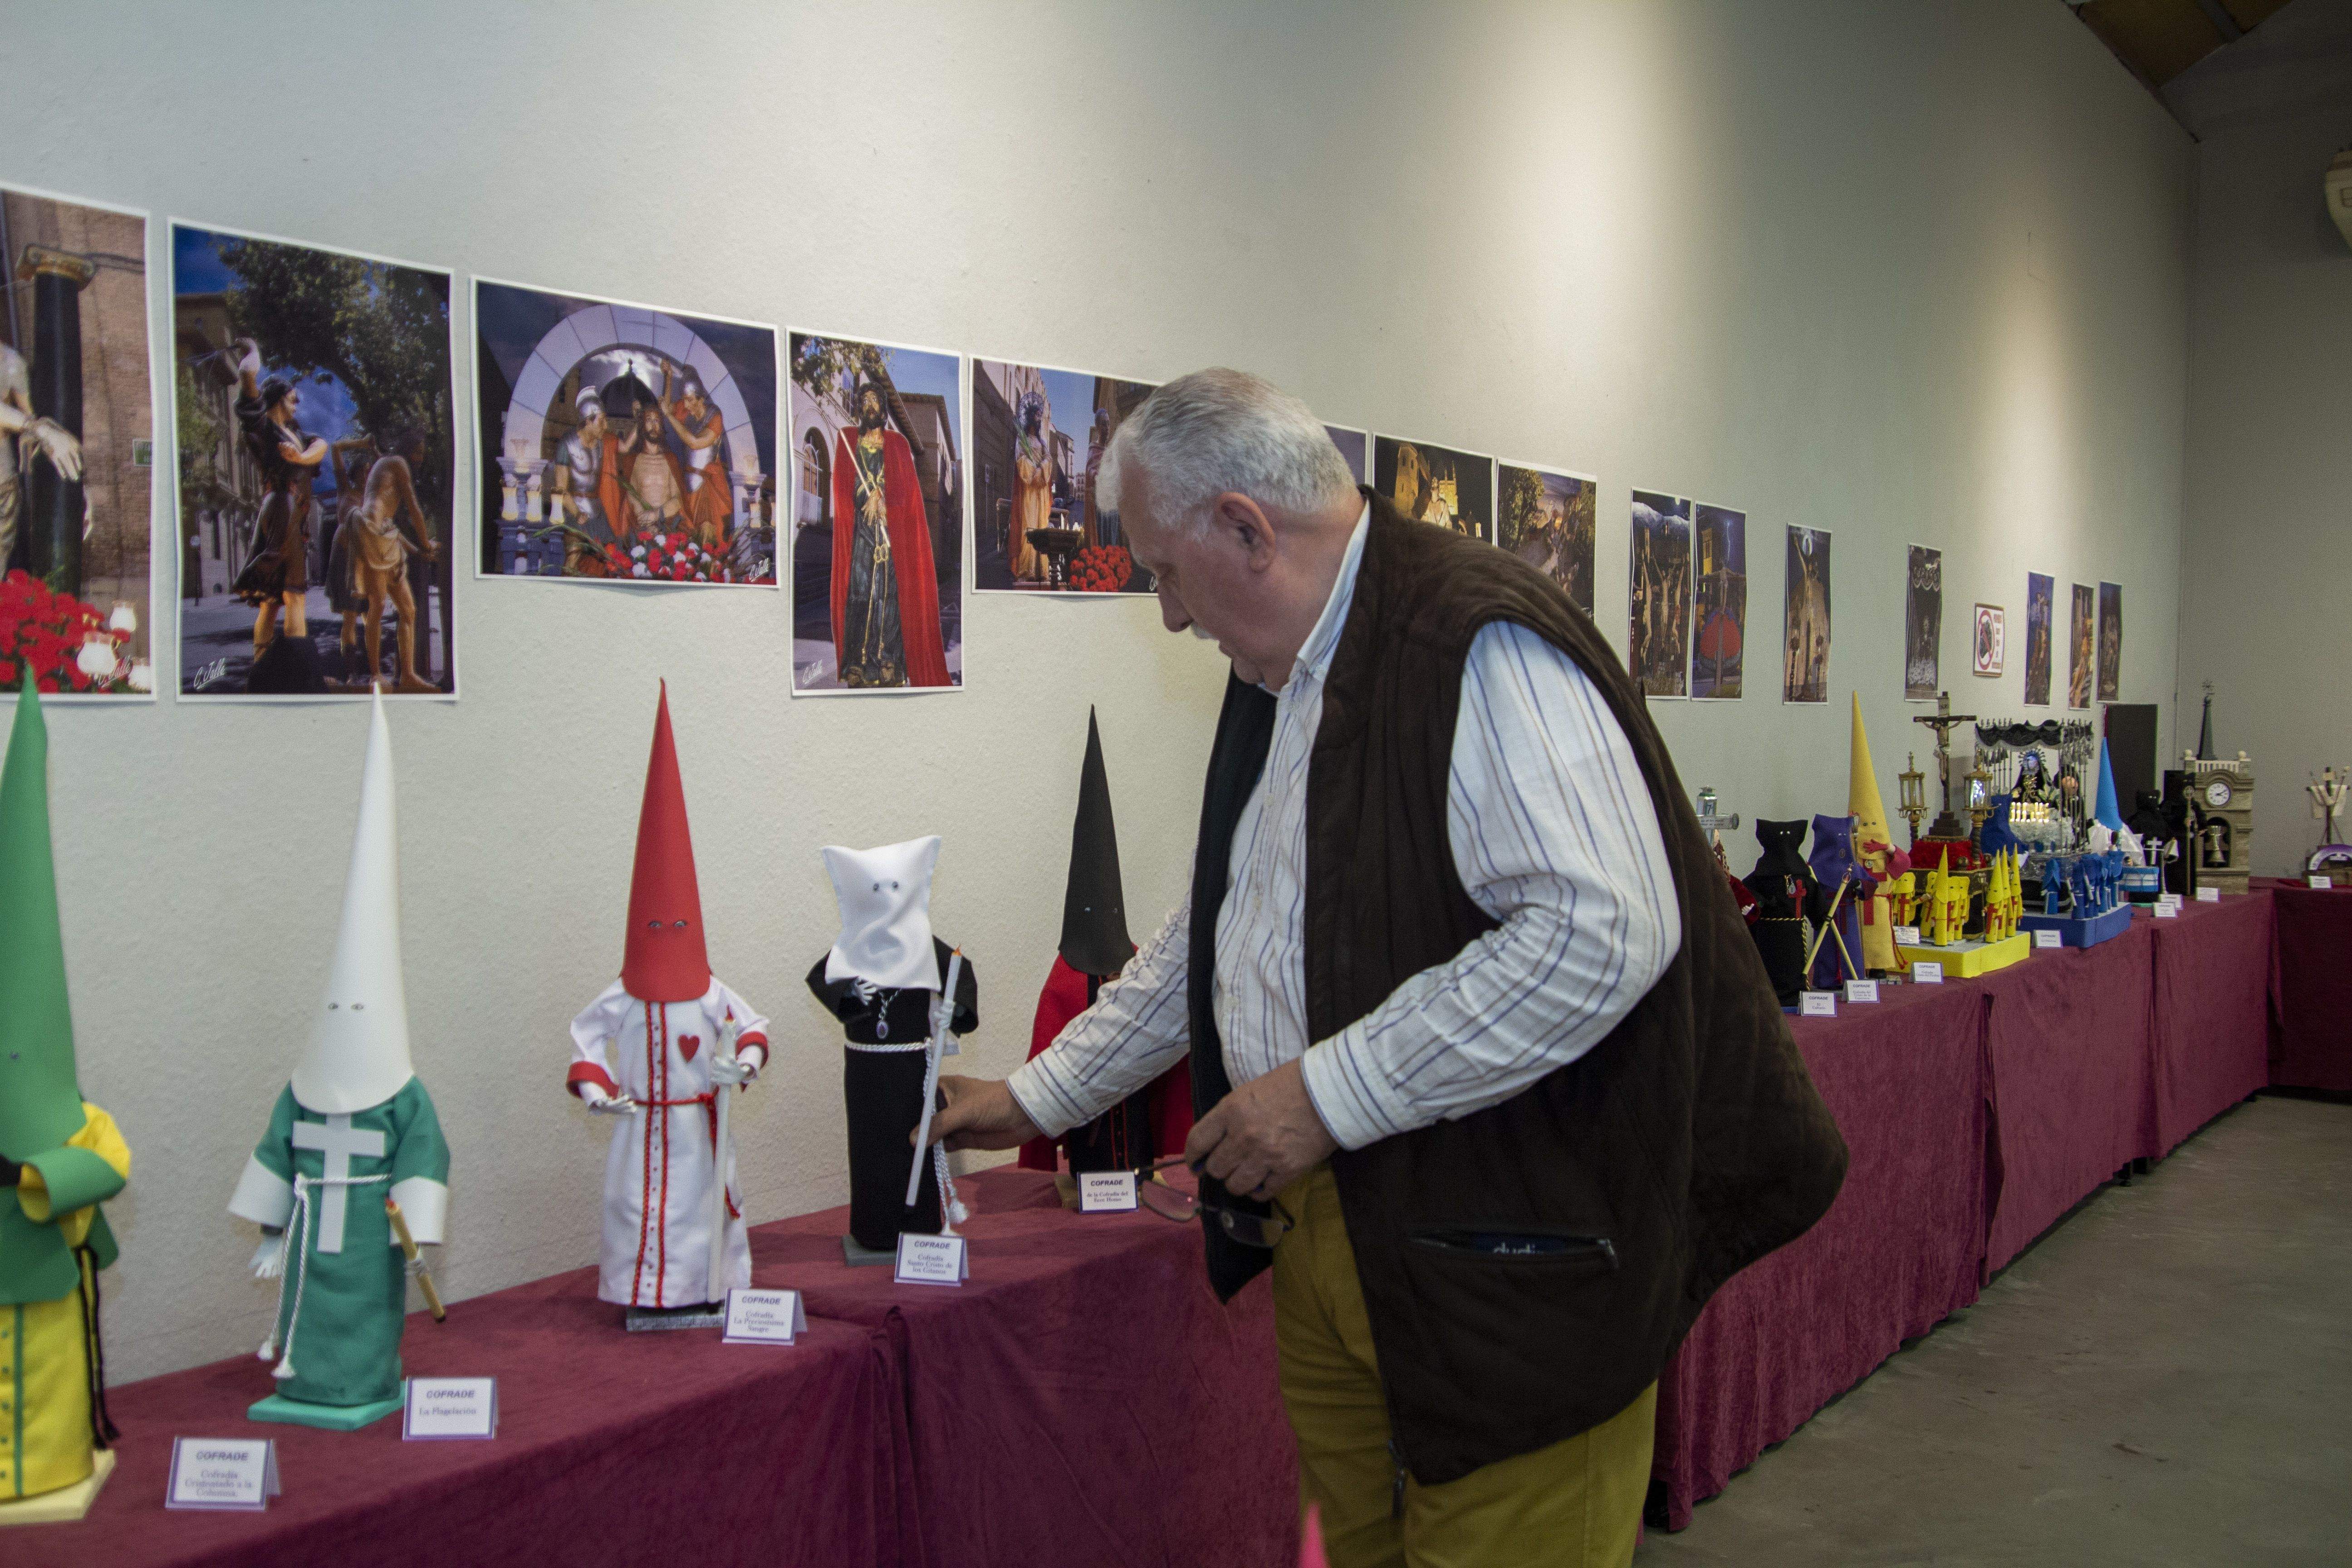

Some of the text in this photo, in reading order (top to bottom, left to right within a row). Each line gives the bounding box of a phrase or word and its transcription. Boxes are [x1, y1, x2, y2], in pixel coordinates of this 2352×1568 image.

[914, 1240, 951, 1250] COFRADE
[741, 1296, 781, 1305] COFRADE
[426, 1390, 475, 1399] COFRADE
[419, 1407, 429, 1416] La
[196, 1451, 249, 1461] COFRADE
